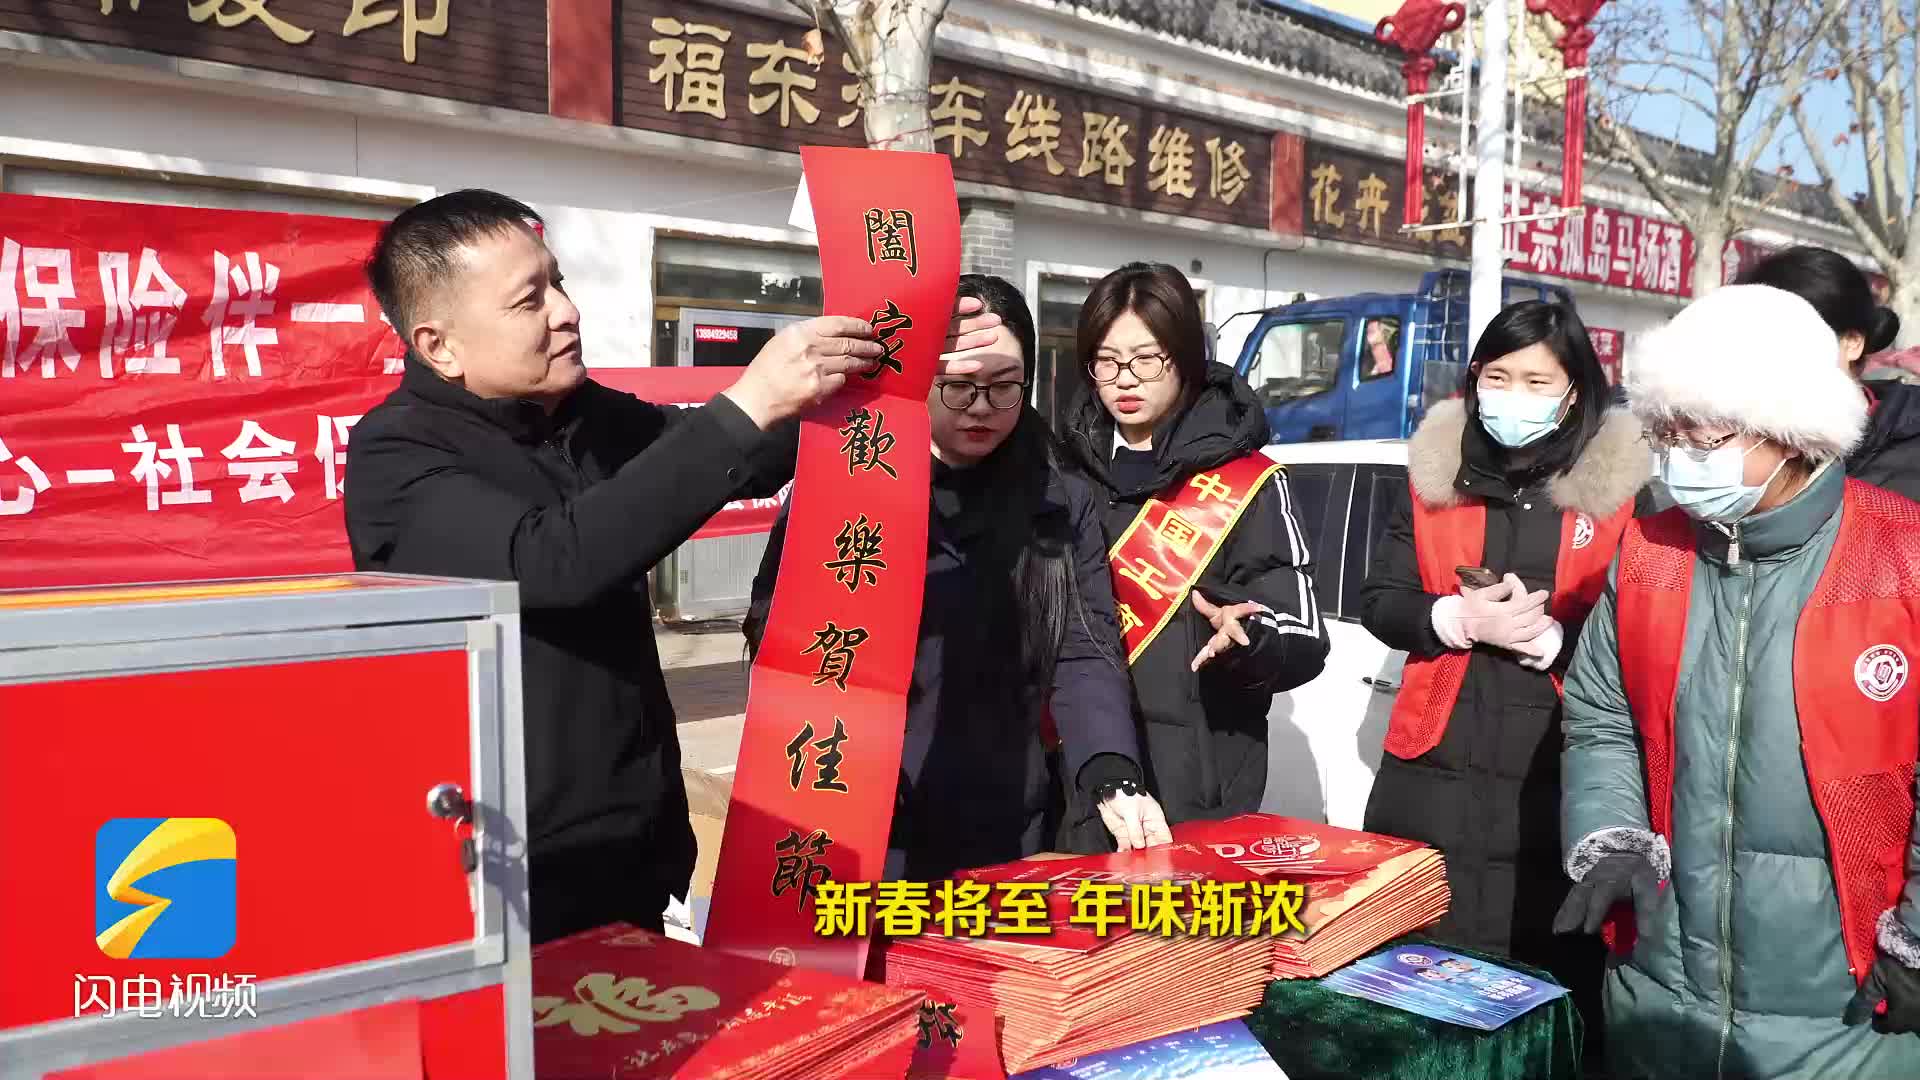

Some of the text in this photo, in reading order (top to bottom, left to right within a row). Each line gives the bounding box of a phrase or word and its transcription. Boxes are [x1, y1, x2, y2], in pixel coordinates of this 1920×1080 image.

[649, 16, 1252, 205] 福东车线路维修
[0, 236, 405, 378] 保险伴一
[1502, 192, 1698, 292] 正宗孤岛马场酒
